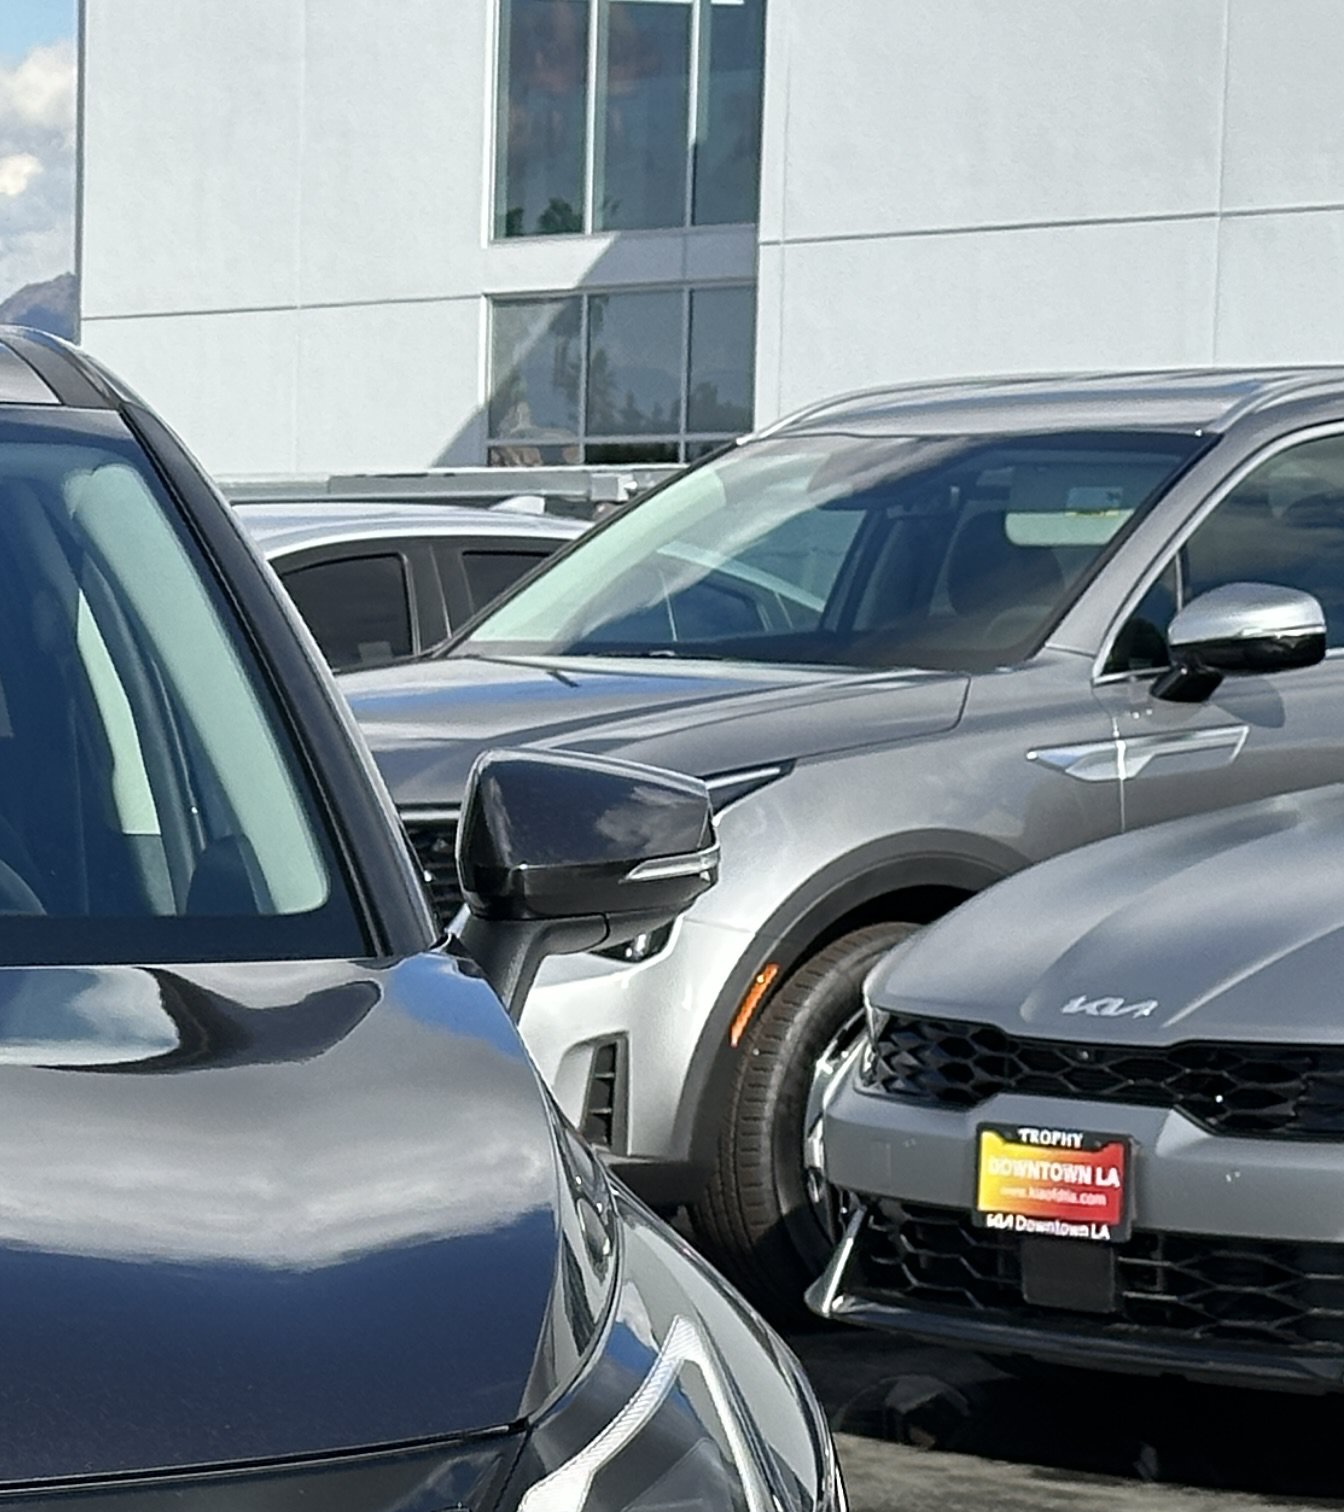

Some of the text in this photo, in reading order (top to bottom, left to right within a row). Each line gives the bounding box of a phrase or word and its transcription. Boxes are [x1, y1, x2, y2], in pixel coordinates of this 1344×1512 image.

[1062, 995, 1158, 1019] KIA
[1017, 1128, 1083, 1148] TROPHY
[989, 1157, 1120, 1188] DOWNTOWN LA
[1015, 1215, 1089, 1237] Downtown
[1091, 1223, 1111, 1241] LA
